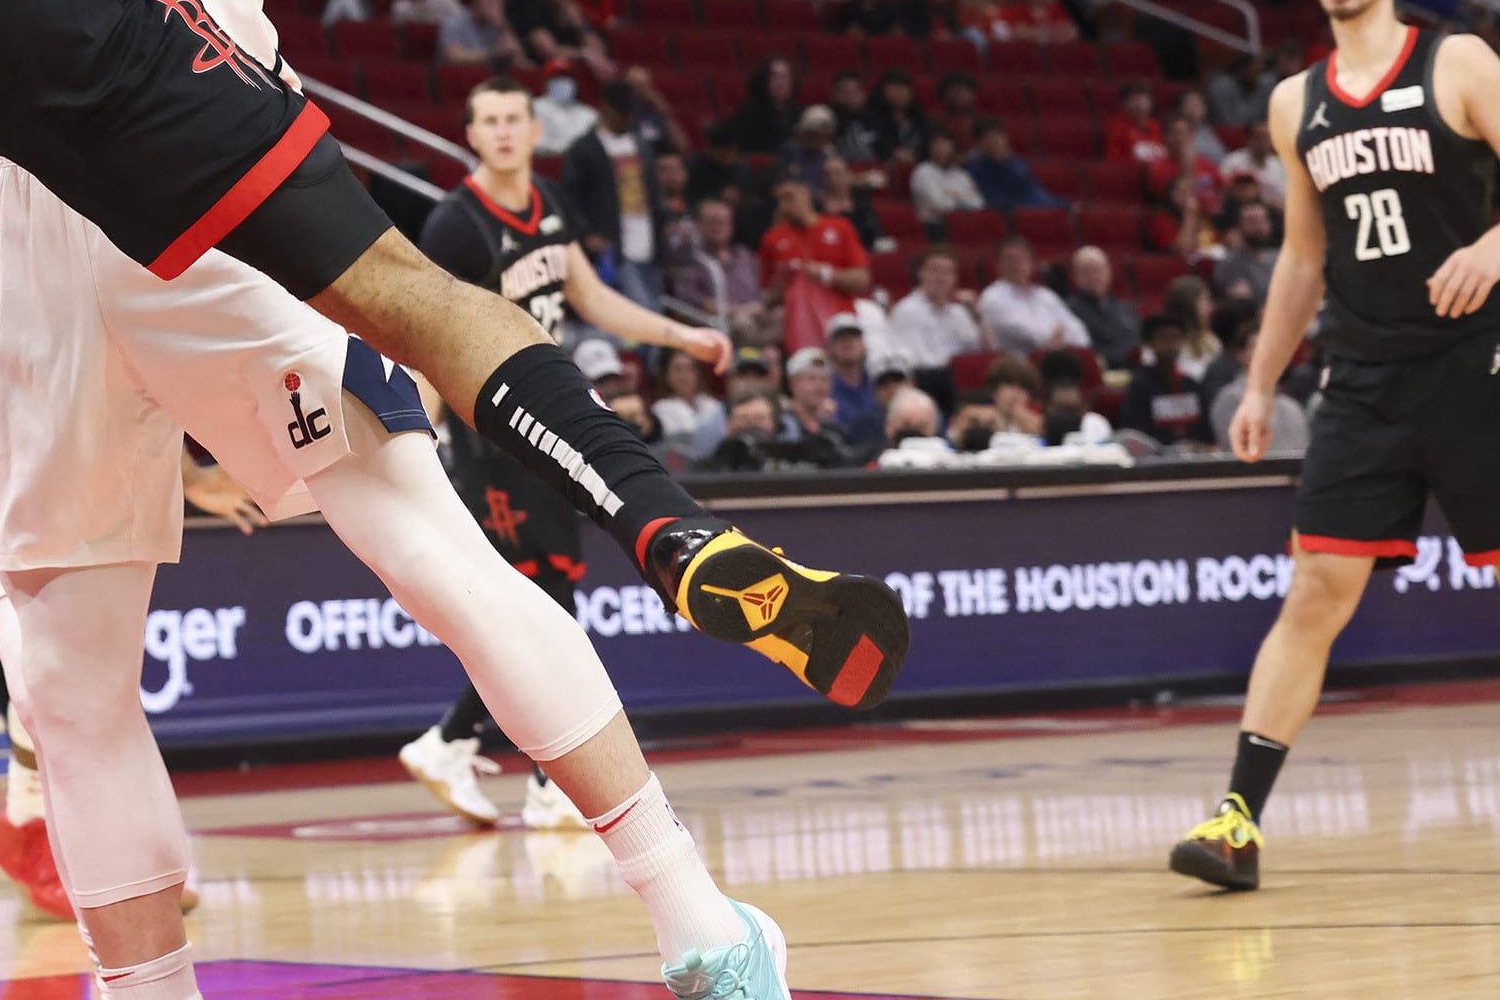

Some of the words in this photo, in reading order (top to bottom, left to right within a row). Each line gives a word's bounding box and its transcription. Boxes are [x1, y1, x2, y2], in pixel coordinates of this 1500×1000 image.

[1305, 127, 1435, 192] HOUSTON
[1344, 188, 1411, 261] 28
[885, 572, 934, 618] OF
[937, 568, 1010, 617] THE
[1014, 558, 1190, 612] HOUSTON
[1195, 553, 1295, 602] ROCK
[286, 598, 441, 653] OFFIC
